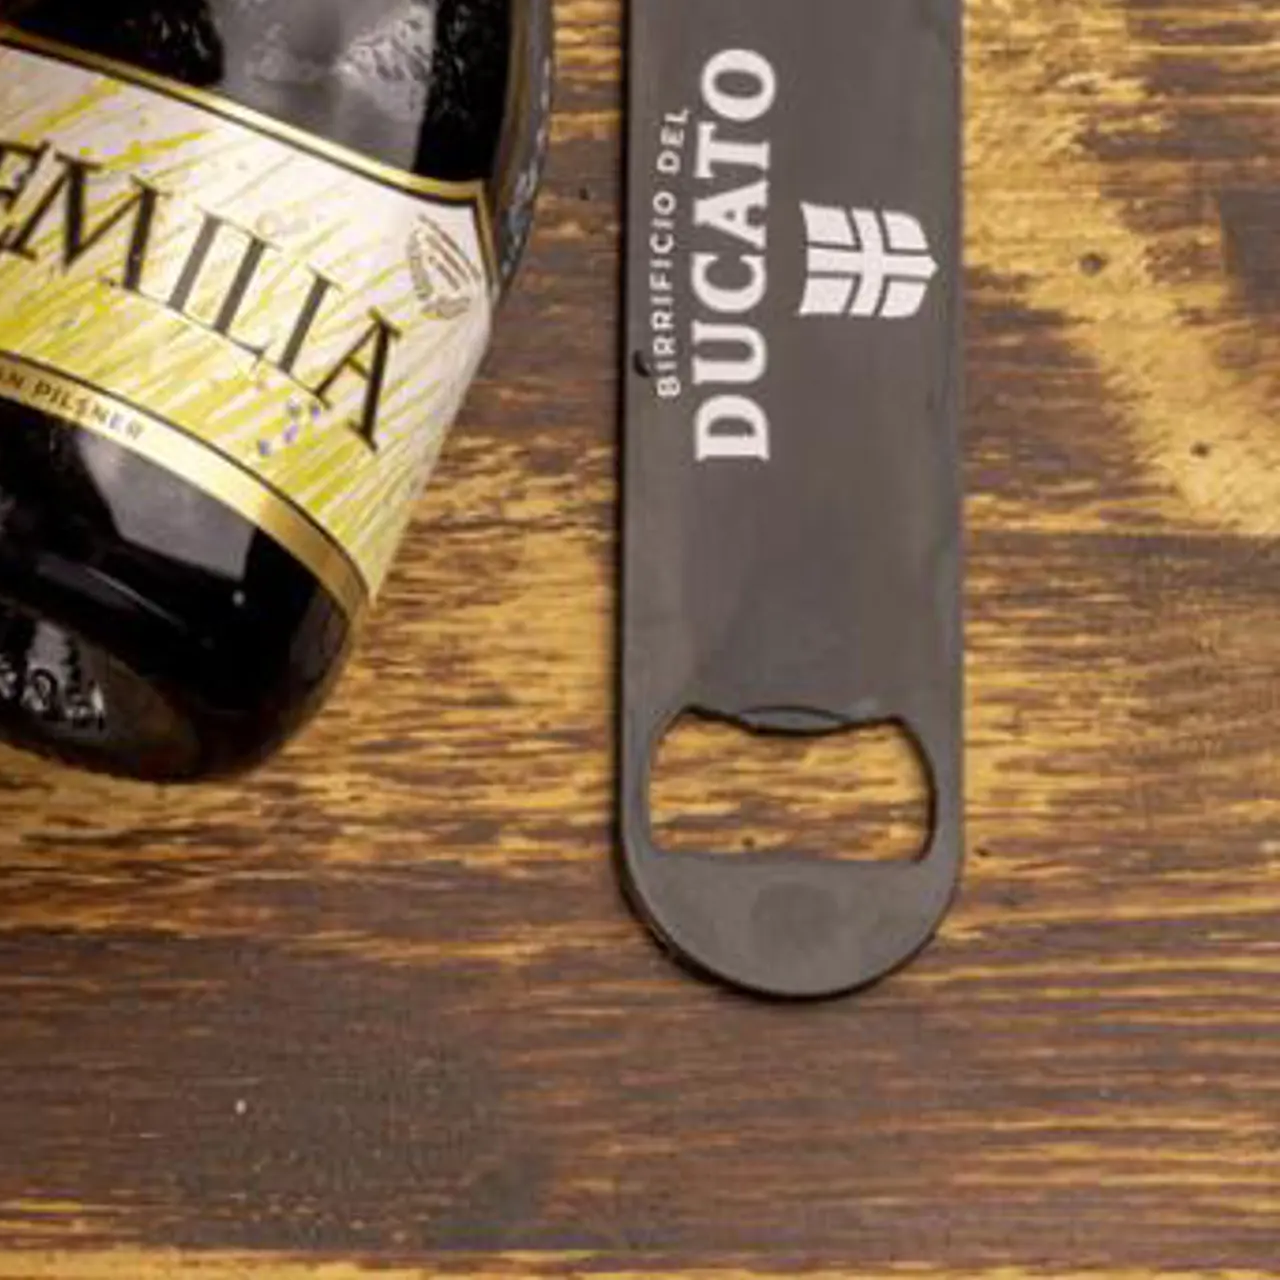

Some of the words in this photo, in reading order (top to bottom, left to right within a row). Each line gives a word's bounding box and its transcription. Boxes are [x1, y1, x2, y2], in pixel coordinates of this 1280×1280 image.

[656, 107, 691, 175] DEL
[648, 191, 682, 398] BIRRIFICIO
[690, 47, 778, 462] DUCATO
[33, 375, 145, 440] PILSNER
